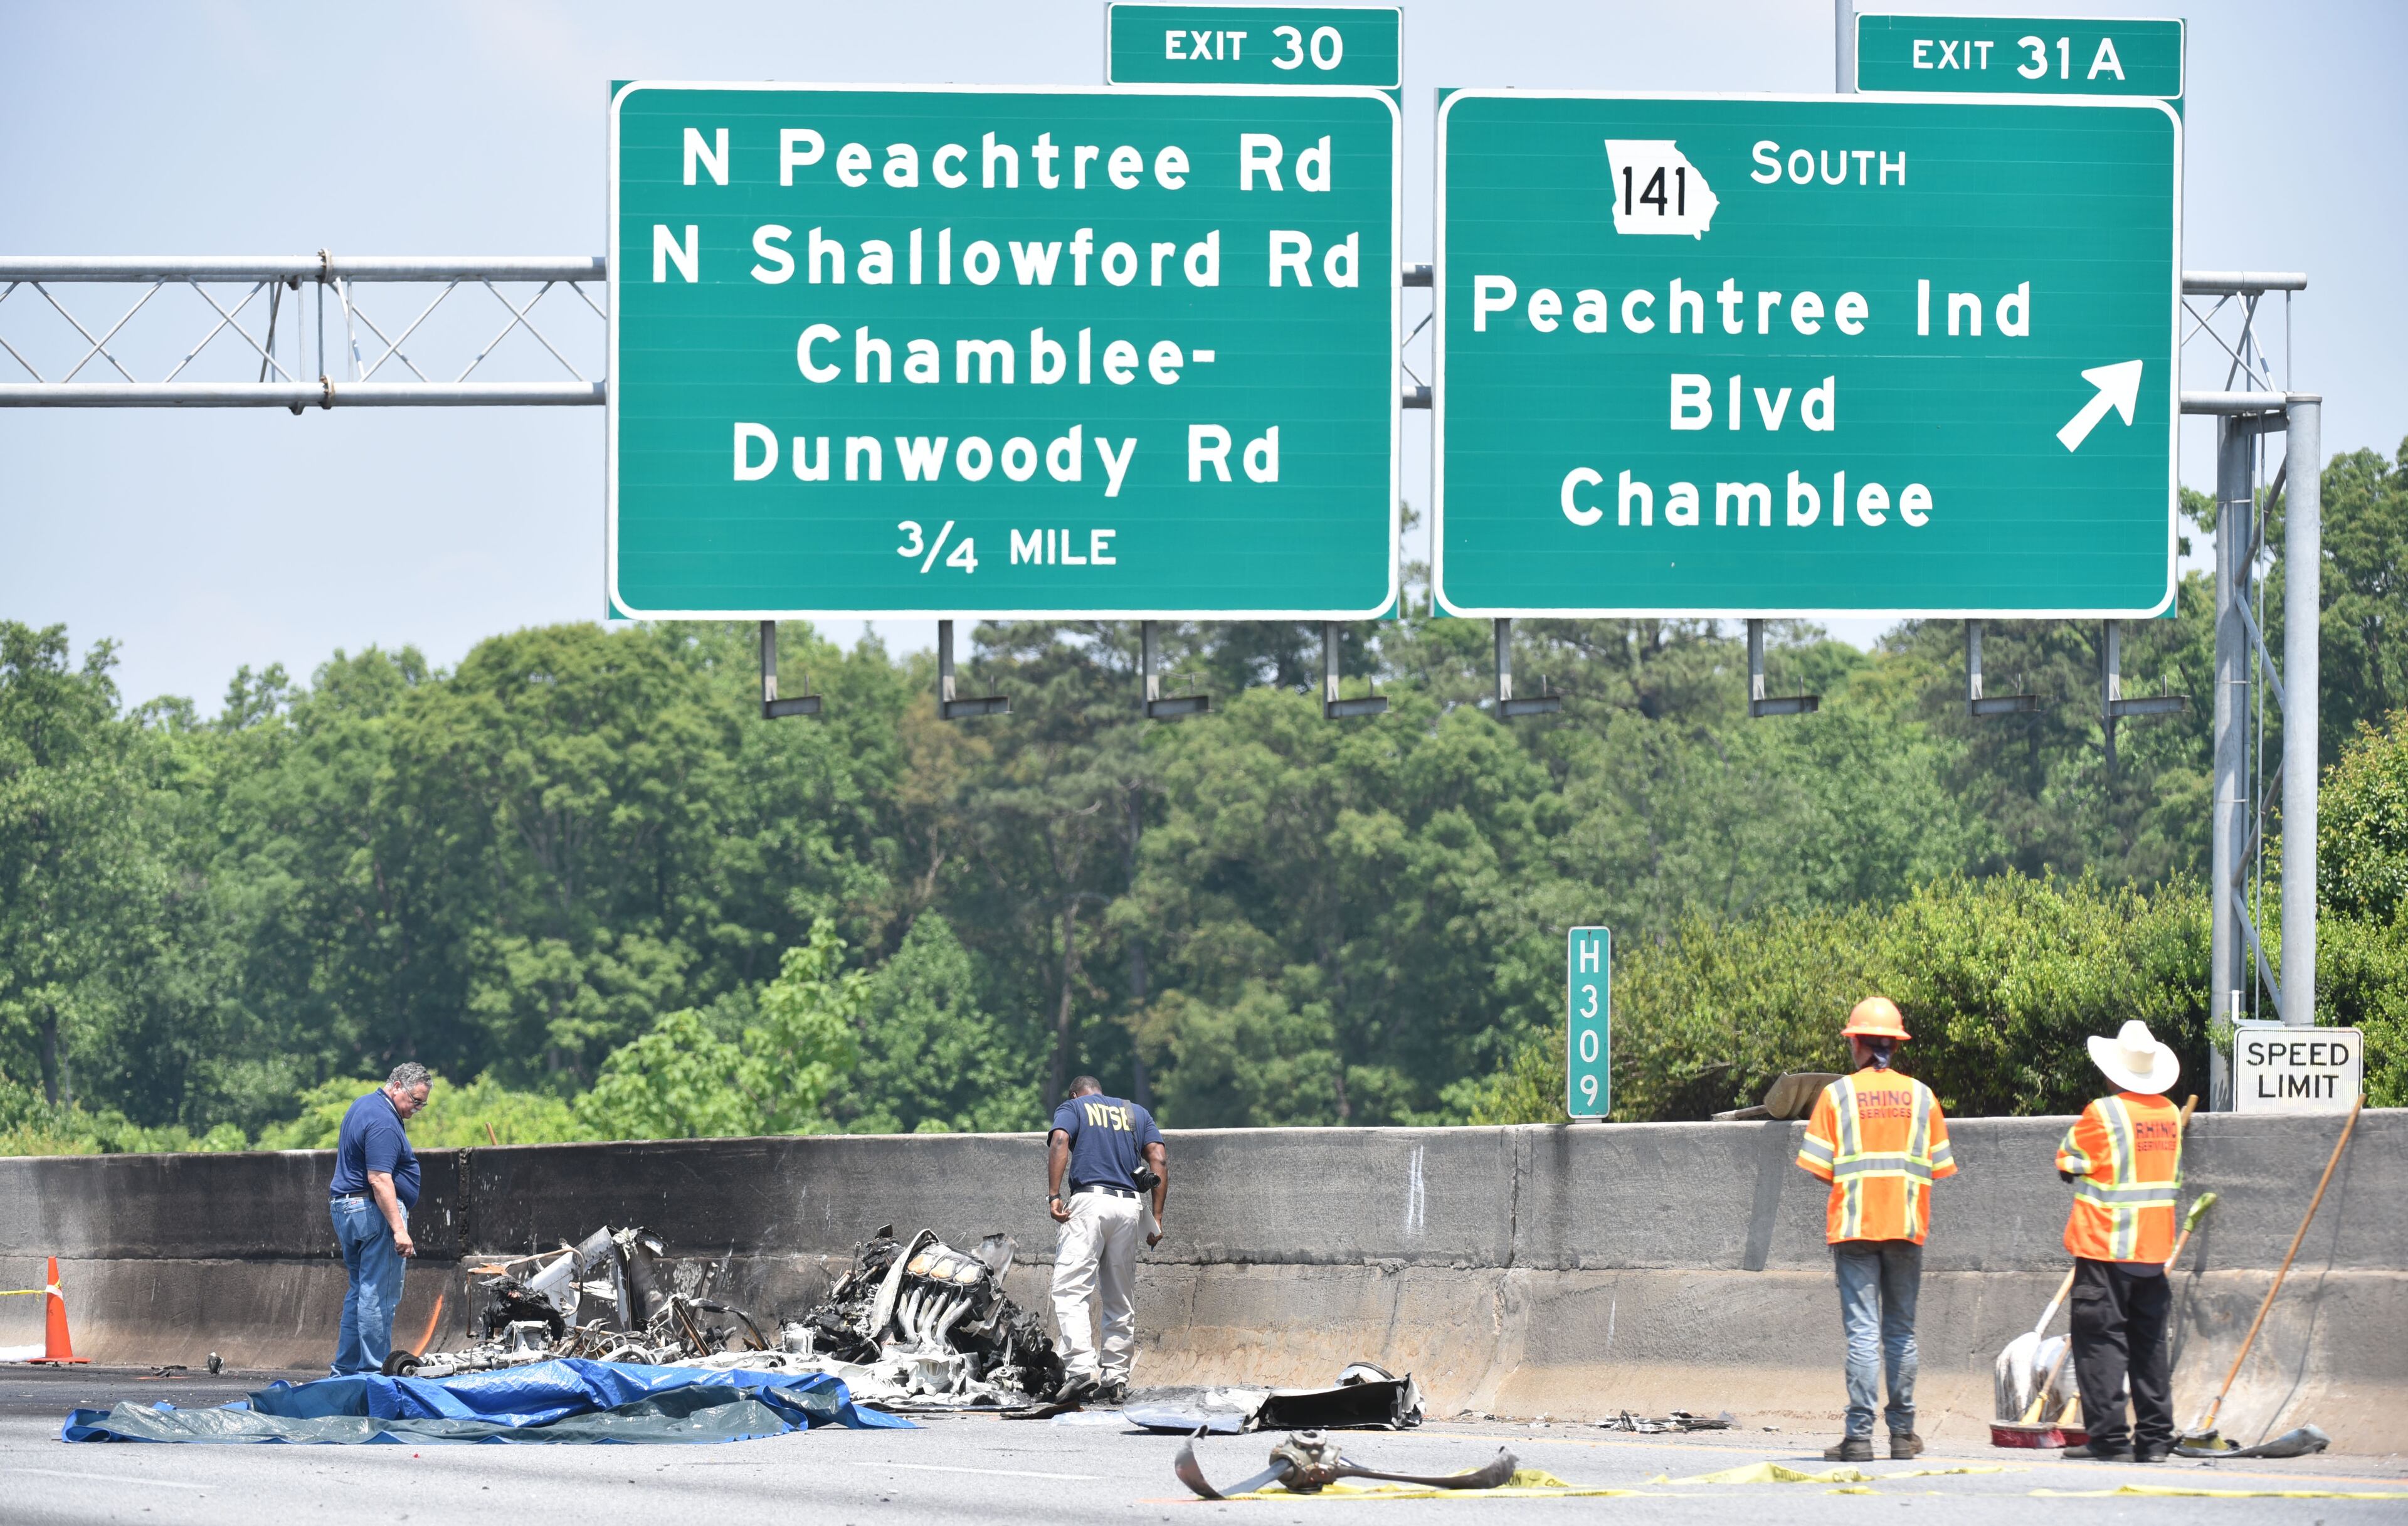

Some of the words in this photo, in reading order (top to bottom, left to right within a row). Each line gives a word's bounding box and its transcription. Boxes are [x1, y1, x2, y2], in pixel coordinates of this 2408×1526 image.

[1165, 29, 1247, 61] EXIT
[1271, 25, 1343, 71] 30
[1913, 39, 1994, 70] EXIT
[683, 127, 729, 186] N
[779, 128, 1190, 191] Peachtree
[1240, 133, 1331, 193] Rd
[1622, 166, 1686, 216] 141
[652, 224, 699, 283] N
[750, 224, 1220, 288] Shallowford
[1269, 230, 1359, 289] Rd
[1474, 275, 1869, 336] Peachtree
[1917, 278, 2030, 337] Ind
[796, 323, 1215, 386] Chamblee-
[1670, 373, 1835, 432] Blvd
[733, 421, 1138, 497] Dunwoody
[1188, 423, 1280, 484] Rd
[1560, 467, 1934, 527] Chamblee
[1010, 529, 1117, 565] MILE
[2247, 1042, 2350, 1066] SPEED
[1856, 1090, 1912, 1107] RHINO
[2258, 1074, 2340, 1098] LIMIT
[1859, 1108, 1912, 1120] SERVICES
